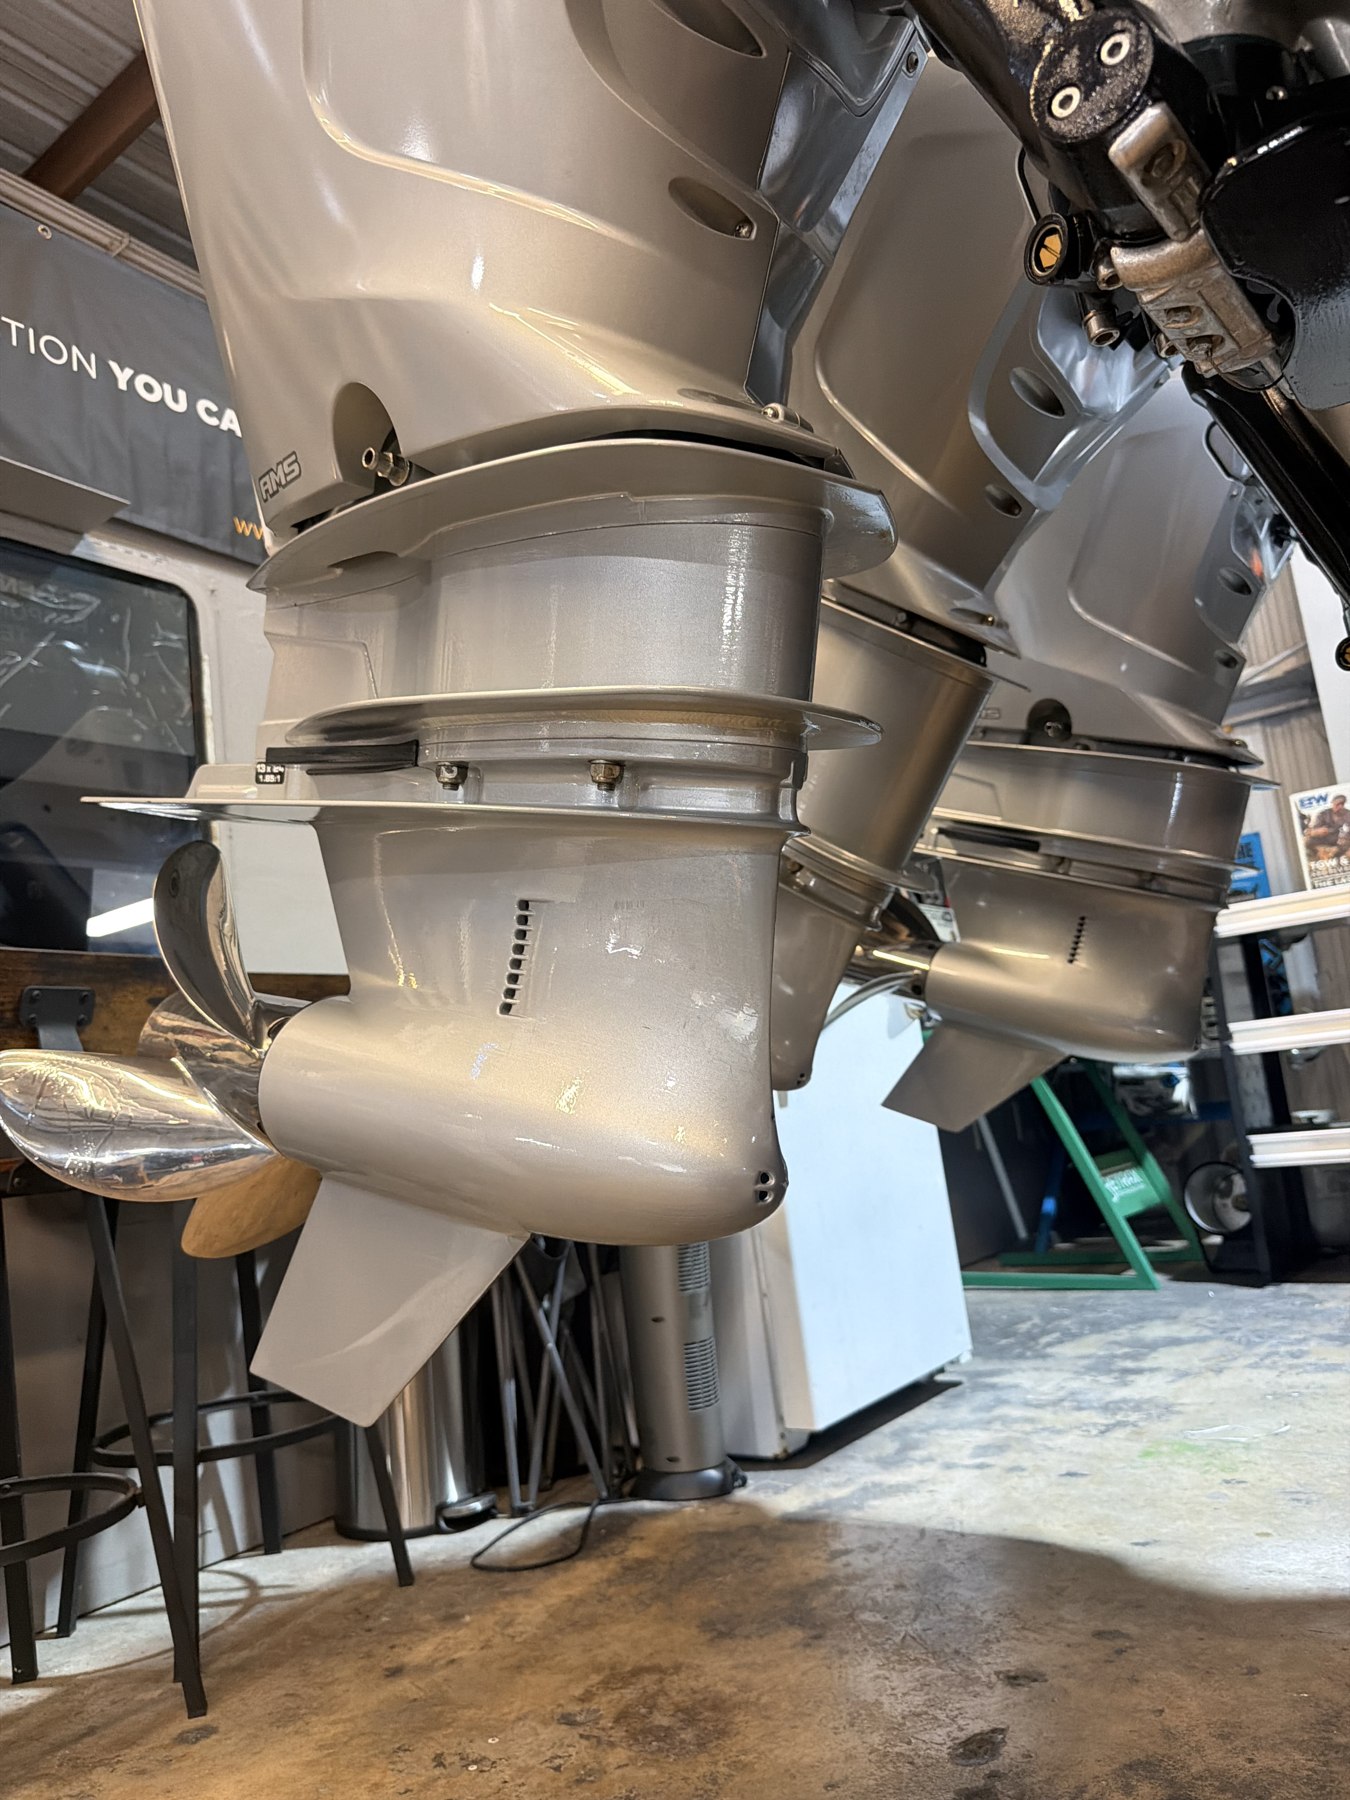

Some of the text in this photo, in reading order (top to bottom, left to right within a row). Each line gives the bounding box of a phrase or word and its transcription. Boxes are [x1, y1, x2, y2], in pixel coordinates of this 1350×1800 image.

[1, 316, 243, 438] TION YOU CA
[258, 450, 302, 503] AMS
